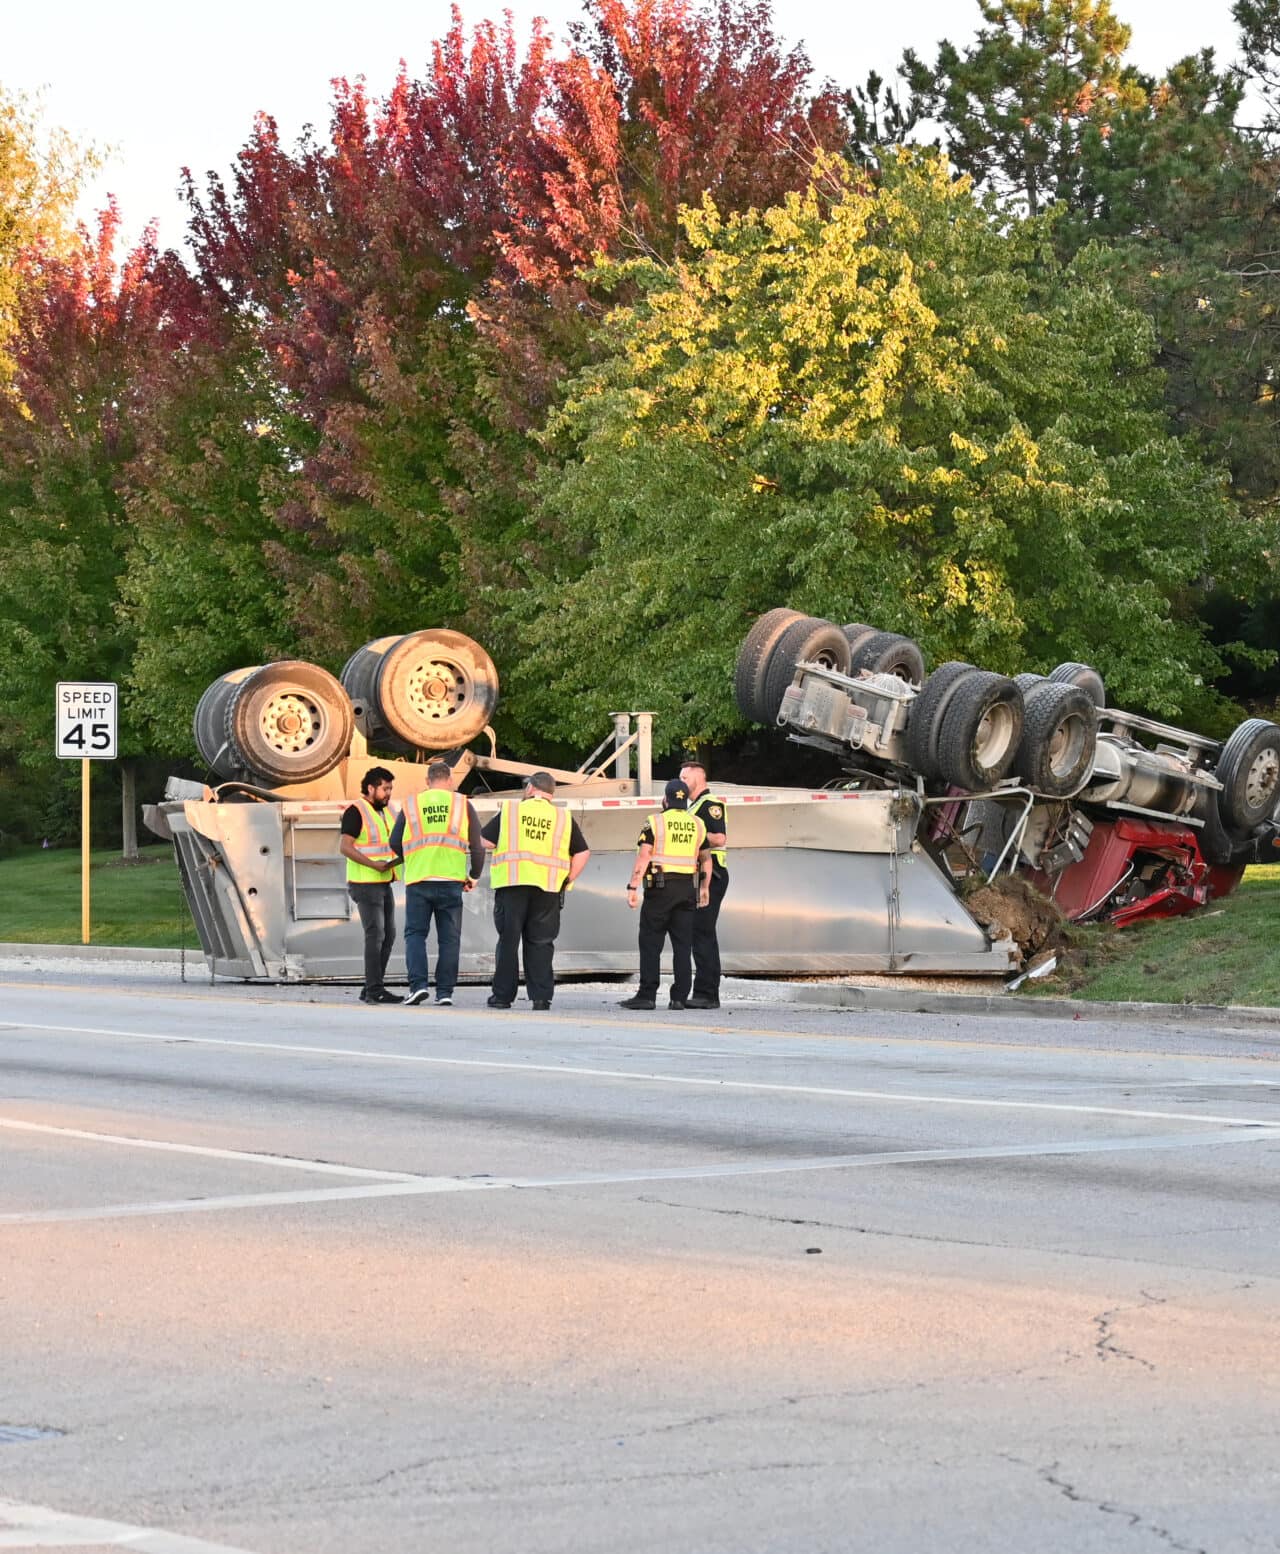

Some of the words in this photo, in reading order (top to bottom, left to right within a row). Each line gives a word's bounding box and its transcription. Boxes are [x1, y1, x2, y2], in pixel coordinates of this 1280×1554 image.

[62, 691, 112, 704] SPEED
[67, 707, 106, 719] LIMIT
[62, 723, 111, 750] 45
[422, 805, 449, 815] POLICE
[426, 814, 447, 824] MCAT
[521, 815, 552, 830] POLICE
[667, 821, 695, 832] POLICE
[525, 827, 547, 841] MCAT
[671, 833, 693, 844] MCAT
